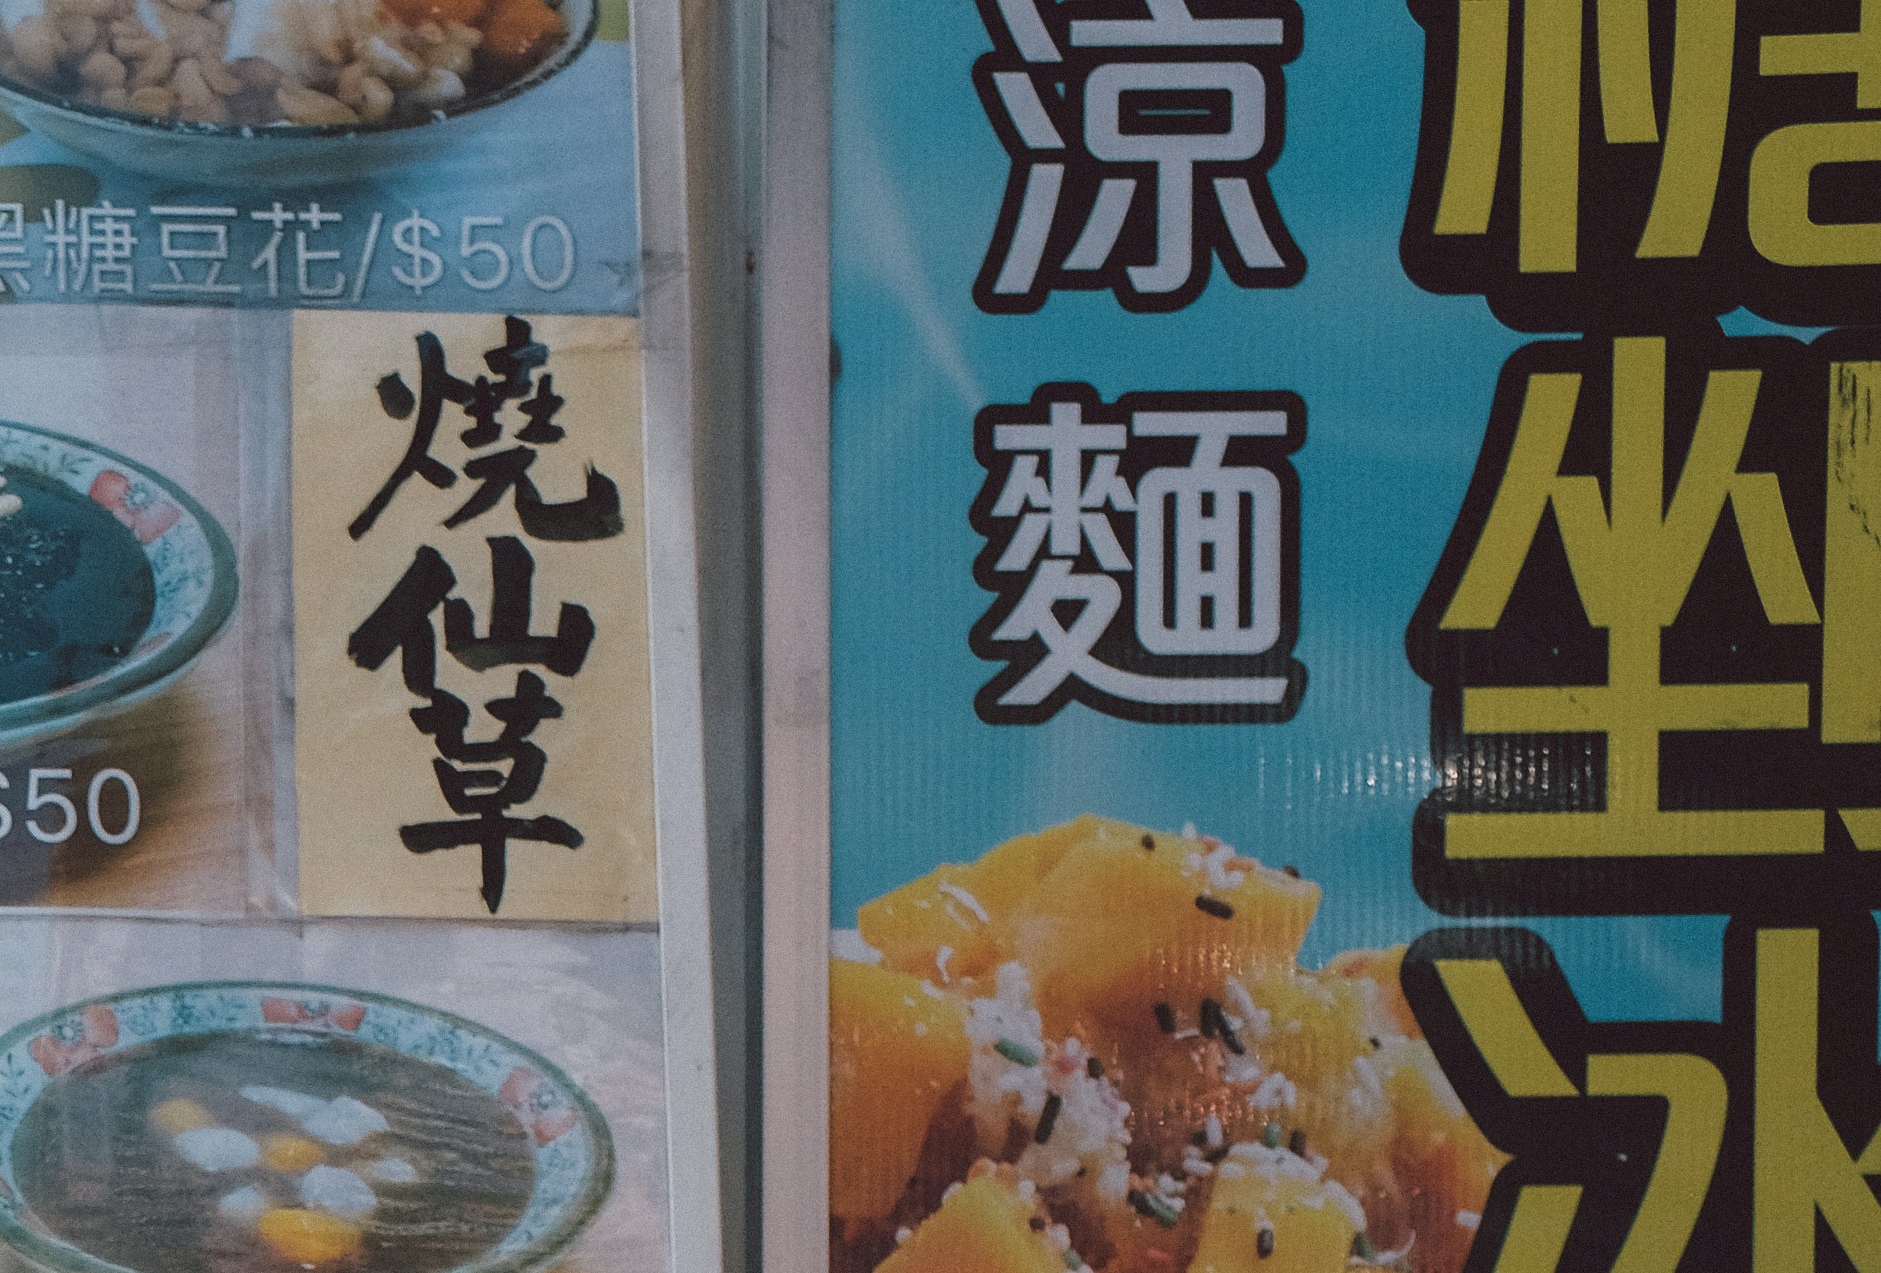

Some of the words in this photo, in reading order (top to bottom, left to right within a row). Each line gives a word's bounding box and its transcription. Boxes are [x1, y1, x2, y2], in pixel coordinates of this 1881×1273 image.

[348, 316, 624, 913] 燒仙草
[990, 0, 1290, 706] 涼麵
